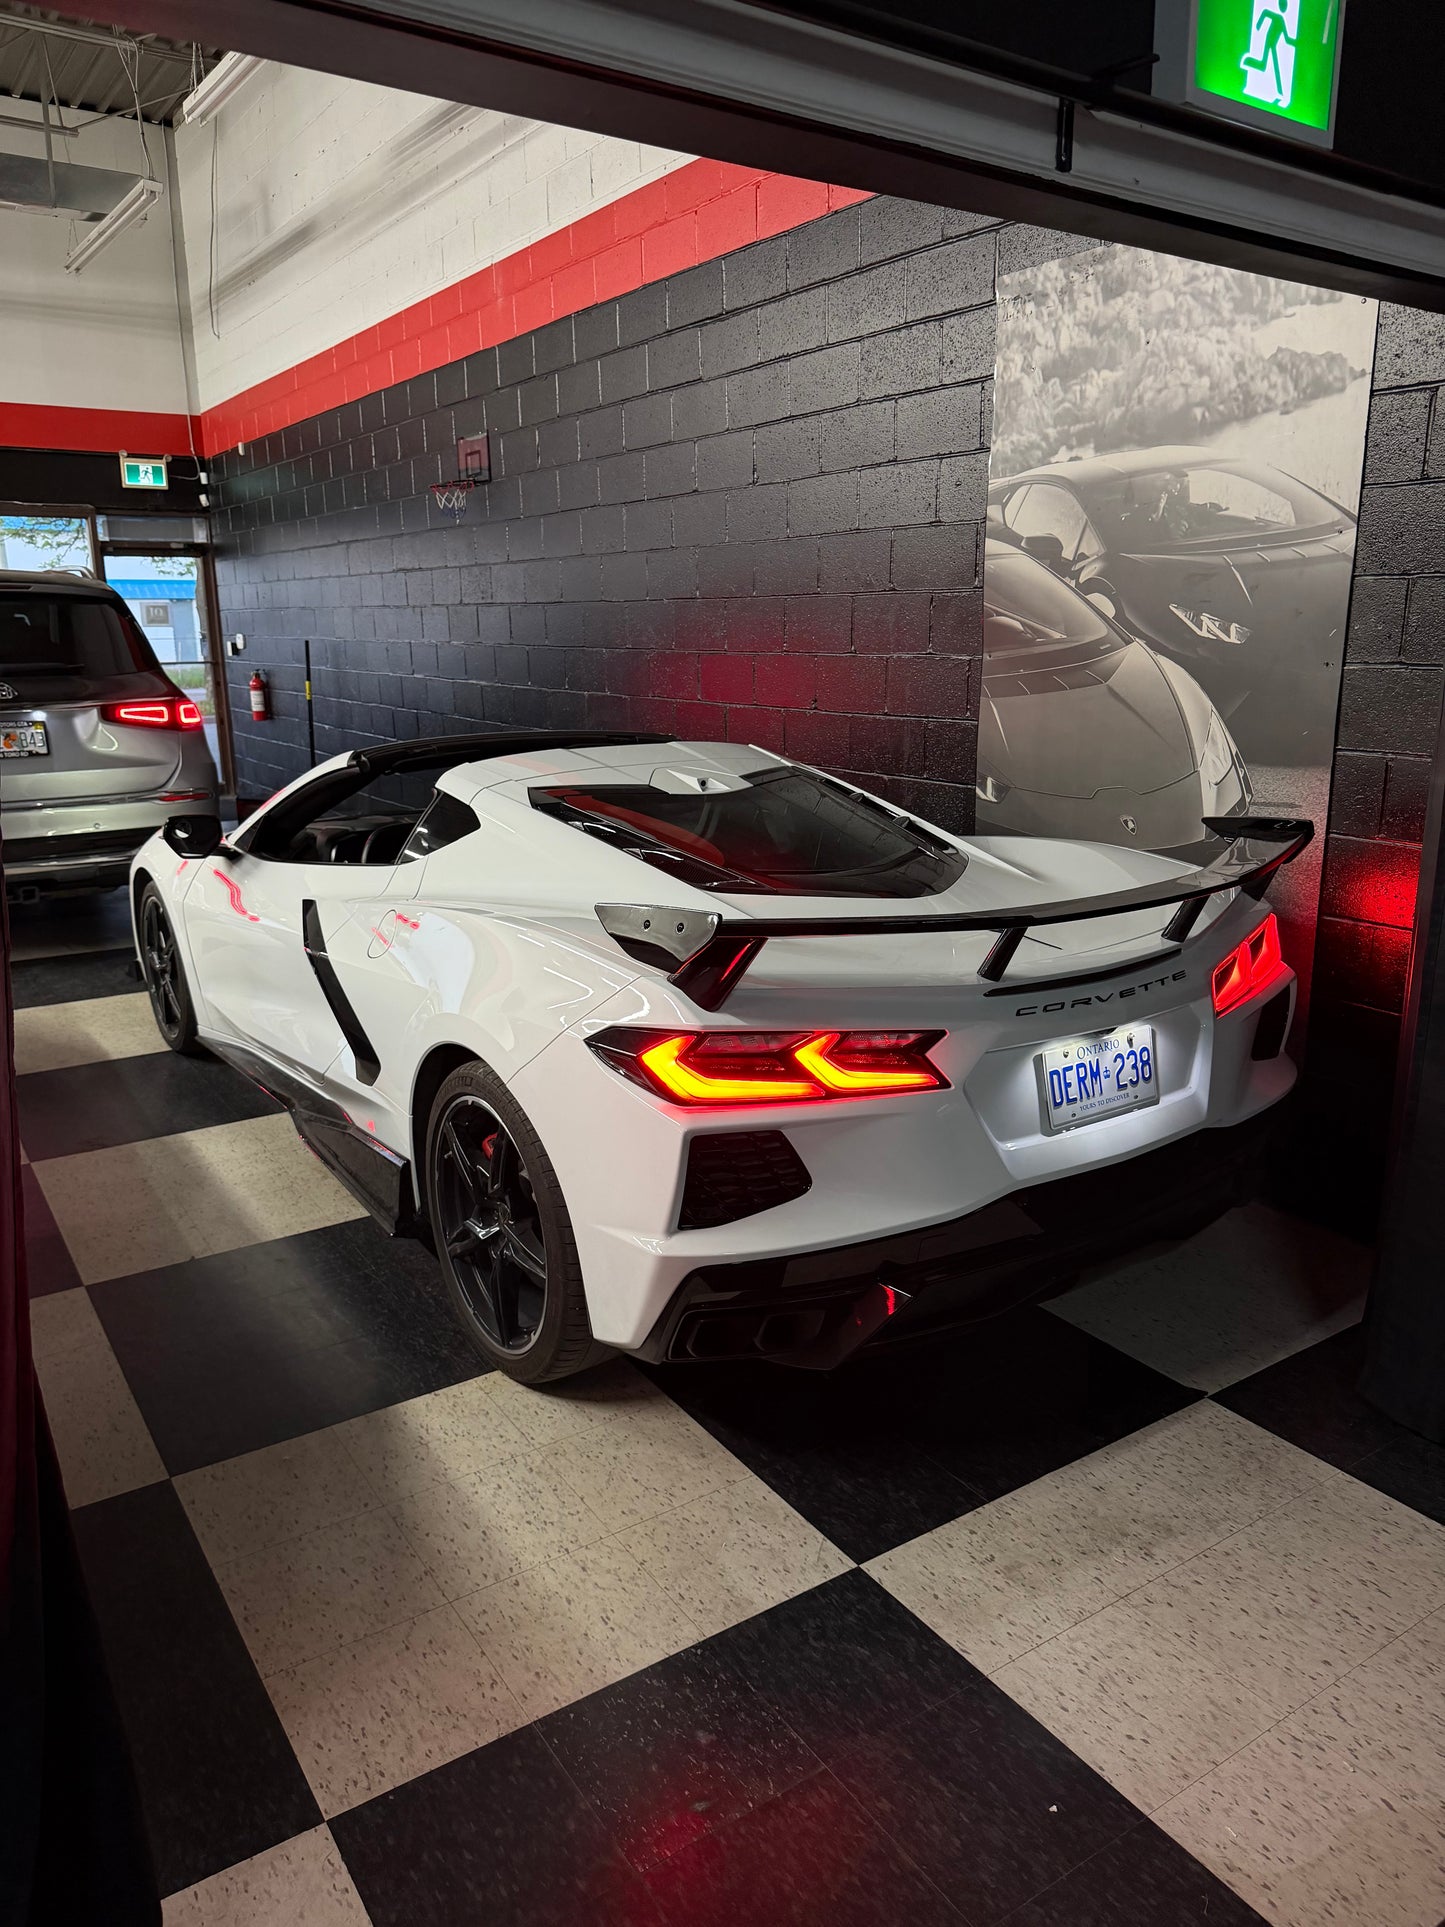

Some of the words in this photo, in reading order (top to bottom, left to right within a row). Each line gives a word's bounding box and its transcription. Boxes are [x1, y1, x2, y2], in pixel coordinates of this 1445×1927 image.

[1016, 969, 1188, 1017] CORVETTE
[1076, 1039, 1120, 1060] ONTARIO
[1049, 1058, 1104, 1108] DERM
[1113, 1046, 1153, 1090] 238
[1080, 1102, 1097, 1111] YOURS
[1105, 1092, 1130, 1104] DISCOVER
